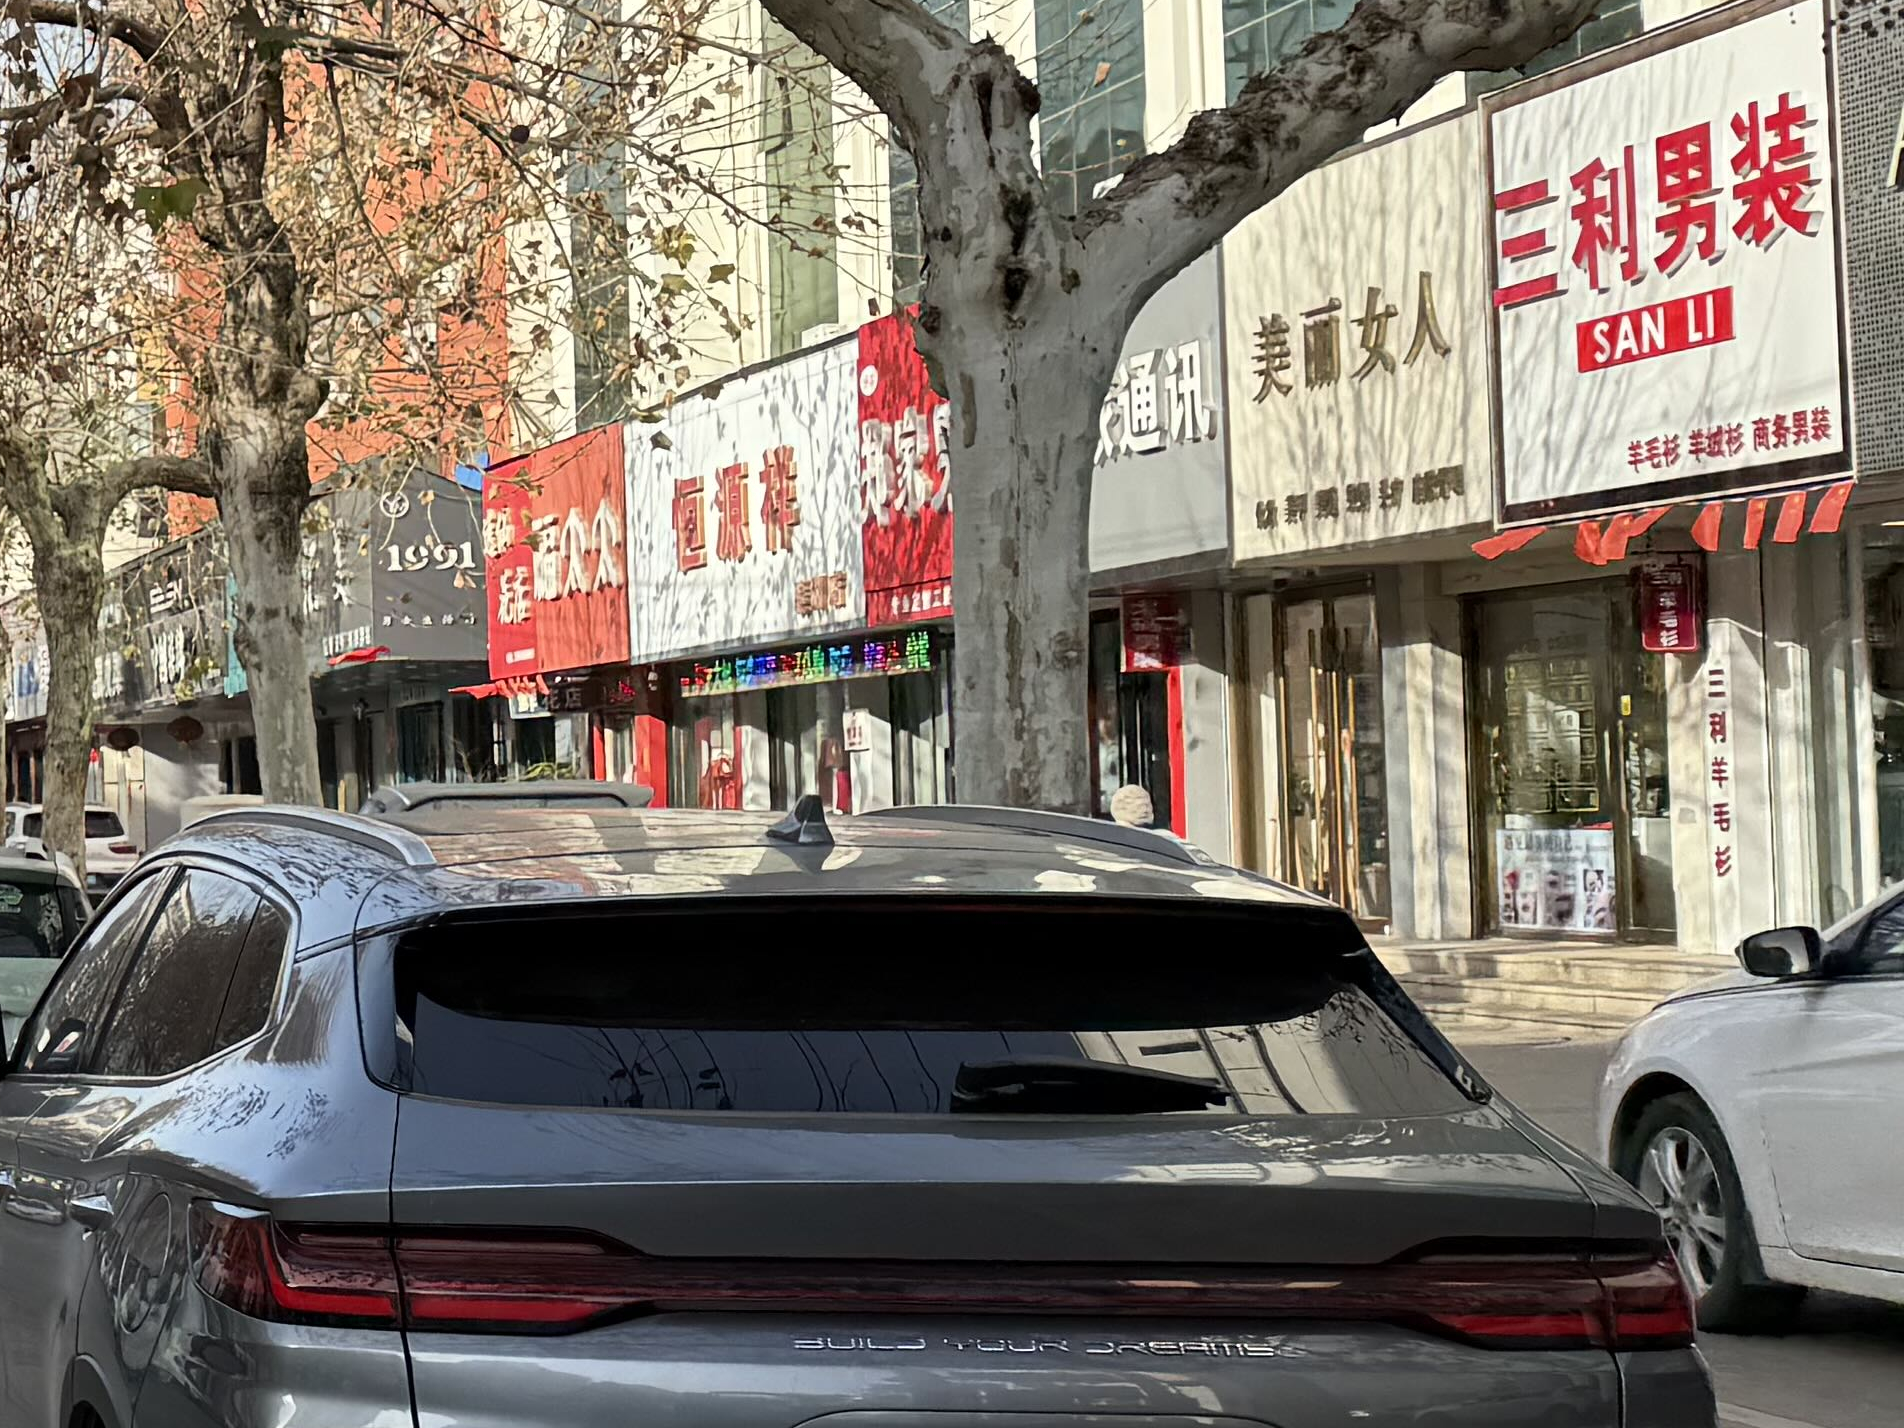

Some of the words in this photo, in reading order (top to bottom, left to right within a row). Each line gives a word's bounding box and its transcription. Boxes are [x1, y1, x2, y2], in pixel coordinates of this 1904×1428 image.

[1494, 92, 1824, 310] 三利男装
[1251, 270, 1453, 406] 美丽女人
[1593, 307, 1666, 365] SAN
[1688, 292, 1716, 344] LI
[1626, 435, 1682, 472] 羊毛衫
[1752, 405, 1833, 453] 商务男装
[384, 541, 477, 572] 1991
[672, 444, 802, 575] 恒源祥
[1706, 667, 1734, 878] 三利羊毛衫
[793, 1336, 927, 1351] BUILD
[942, 1336, 1071, 1353] YOUR
[1084, 1337, 1276, 1358] DREAMS
